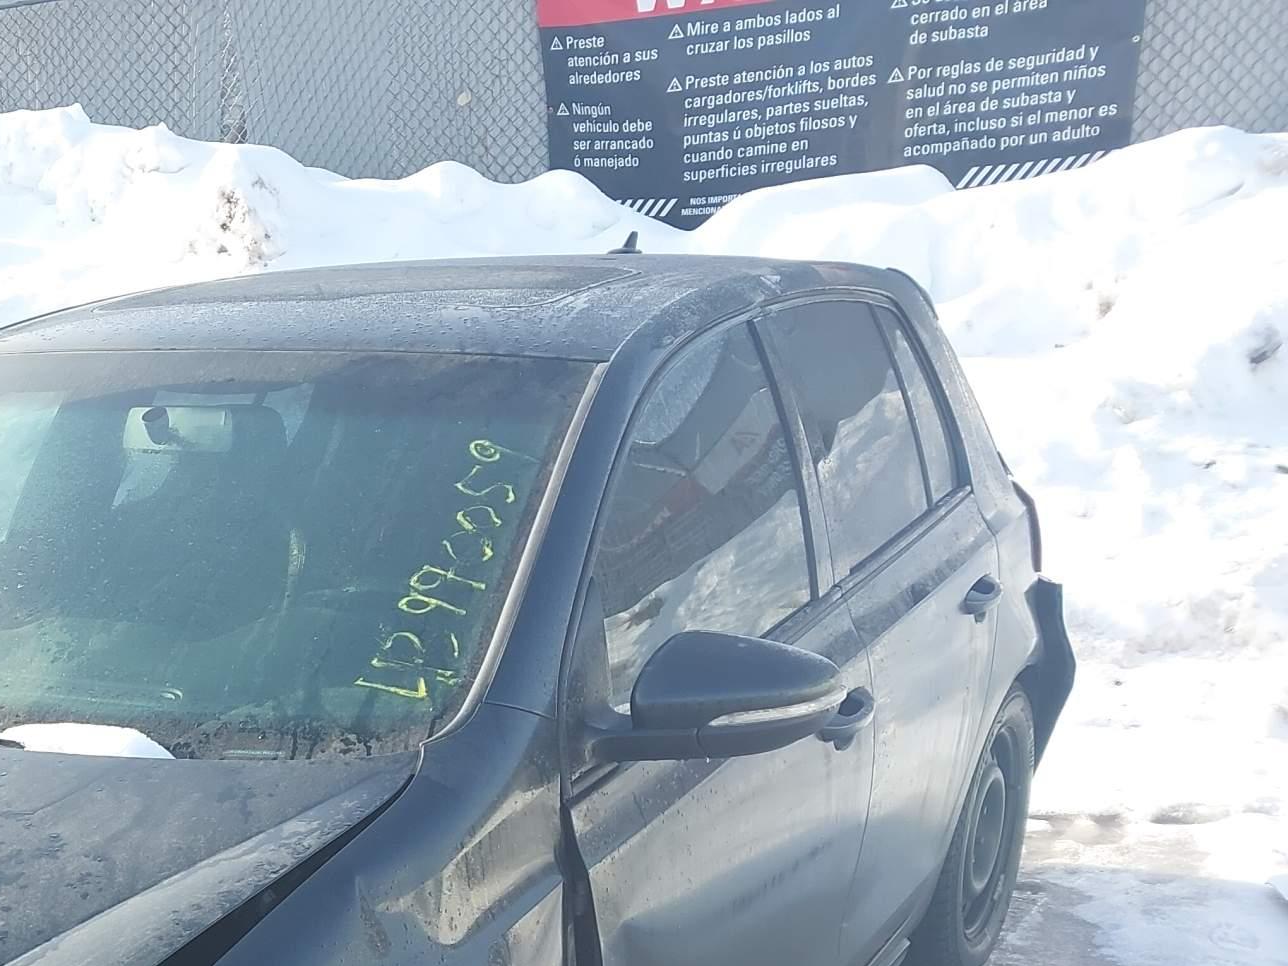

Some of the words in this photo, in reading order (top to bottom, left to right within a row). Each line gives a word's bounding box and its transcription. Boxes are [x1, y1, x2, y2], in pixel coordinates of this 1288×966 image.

[687, 21, 719, 37] Mire
[723, 21, 731, 32] a
[735, 13, 781, 31] ambos
[785, 8, 823, 24] lados
[827, 3, 840, 19] al
[910, 8, 967, 26] cerrado
[971, 6, 990, 19] en
[994, 0, 1009, 16] el
[1012, 0, 1047, 13] área
[566, 36, 604, 50] Preste
[686, 40, 730, 56] cruzar
[733, 35, 754, 50] los
[757, 29, 811, 50] pasillos
[909, 29, 927, 45] de
[931, 25, 988, 42] subasta
[567, 51, 619, 67] atención
[622, 52, 631, 63] a
[634, 49, 658, 62] sus
[907, 66, 933, 80] Por
[936, 60, 981, 79] reglas
[985, 57, 1004, 72] de
[1008, 44, 1087, 70] seguridad
[1089, 46, 1100, 61] y
[569, 70, 641, 85] alrededores
[685, 74, 729, 90] Preste
[733, 64, 793, 84] atención
[797, 65, 806, 76] a
[809, 60, 830, 74] los
[834, 55, 873, 70] autos
[906, 82, 945, 100] salud
[948, 83, 966, 95] no
[970, 81, 988, 93] se
[991, 72, 1059, 94] permiten
[1063, 64, 1106, 82] niños
[684, 77, 823, 110] cargadores/forklifts,
[827, 72, 877, 90] bordes
[905, 107, 923, 119] en
[927, 102, 940, 117] el
[943, 100, 975, 115] área
[980, 96, 998, 112] de
[1002, 90, 1062, 109] subasta
[1066, 89, 1076, 104] y
[572, 102, 611, 118] Ningún
[683, 109, 762, 130] irregulares,
[766, 101, 810, 120] partes
[814, 94, 868, 111] sueltas,
[904, 123, 950, 138] oferta,
[954, 117, 1006, 133] incluso
[1010, 112, 1023, 128] si
[1027, 110, 1041, 126] el
[1044, 106, 1095, 123] menor
[1097, 104, 1118, 117] es
[573, 120, 619, 133] vehículo
[622, 118, 652, 133] debe
[683, 131, 729, 149] puntas
[733, 126, 741, 140] ú
[745, 122, 796, 140] objetos
[799, 116, 845, 132] filosos
[849, 114, 858, 129] y
[573, 140, 591, 150] ser
[594, 136, 654, 150] arrancado
[683, 146, 733, 164] cuando
[737, 140, 787, 158] camine
[791, 139, 808, 151] en
[903, 135, 996, 157] acompañado
[1000, 134, 1026, 151] por
[1029, 132, 1048, 145] un
[1052, 124, 1100, 142] adulto
[574, 154, 581, 167] ó
[584, 154, 639, 170] manejado
[683, 162, 757, 183] superficies
[761, 155, 837, 174] irregulares
[690, 197, 706, 205] NOS
